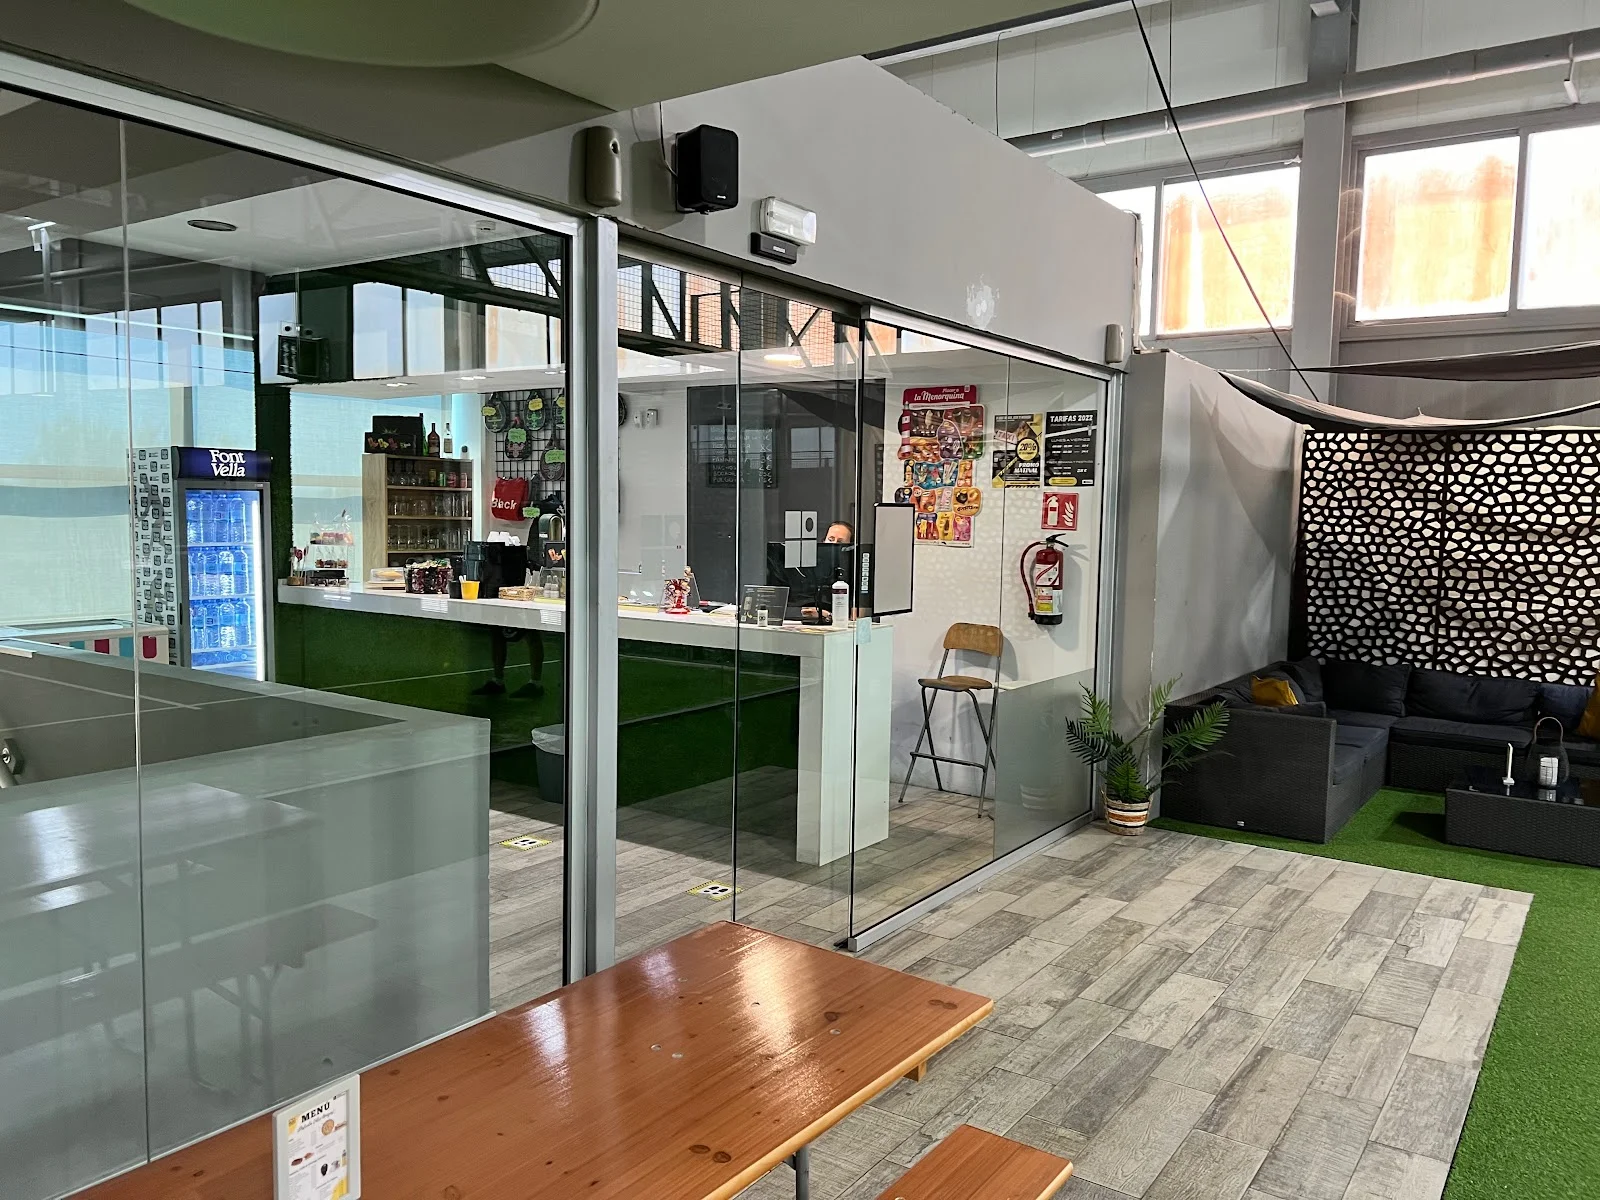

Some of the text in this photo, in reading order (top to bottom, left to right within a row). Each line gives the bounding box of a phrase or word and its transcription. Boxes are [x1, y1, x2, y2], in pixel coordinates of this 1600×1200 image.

[921, 390, 965, 402] Menorquina
[1050, 414, 1094, 423] TARIFAS 2022
[209, 449, 246, 463] Font
[211, 462, 246, 477] Vella
[491, 497, 517, 510] Black
